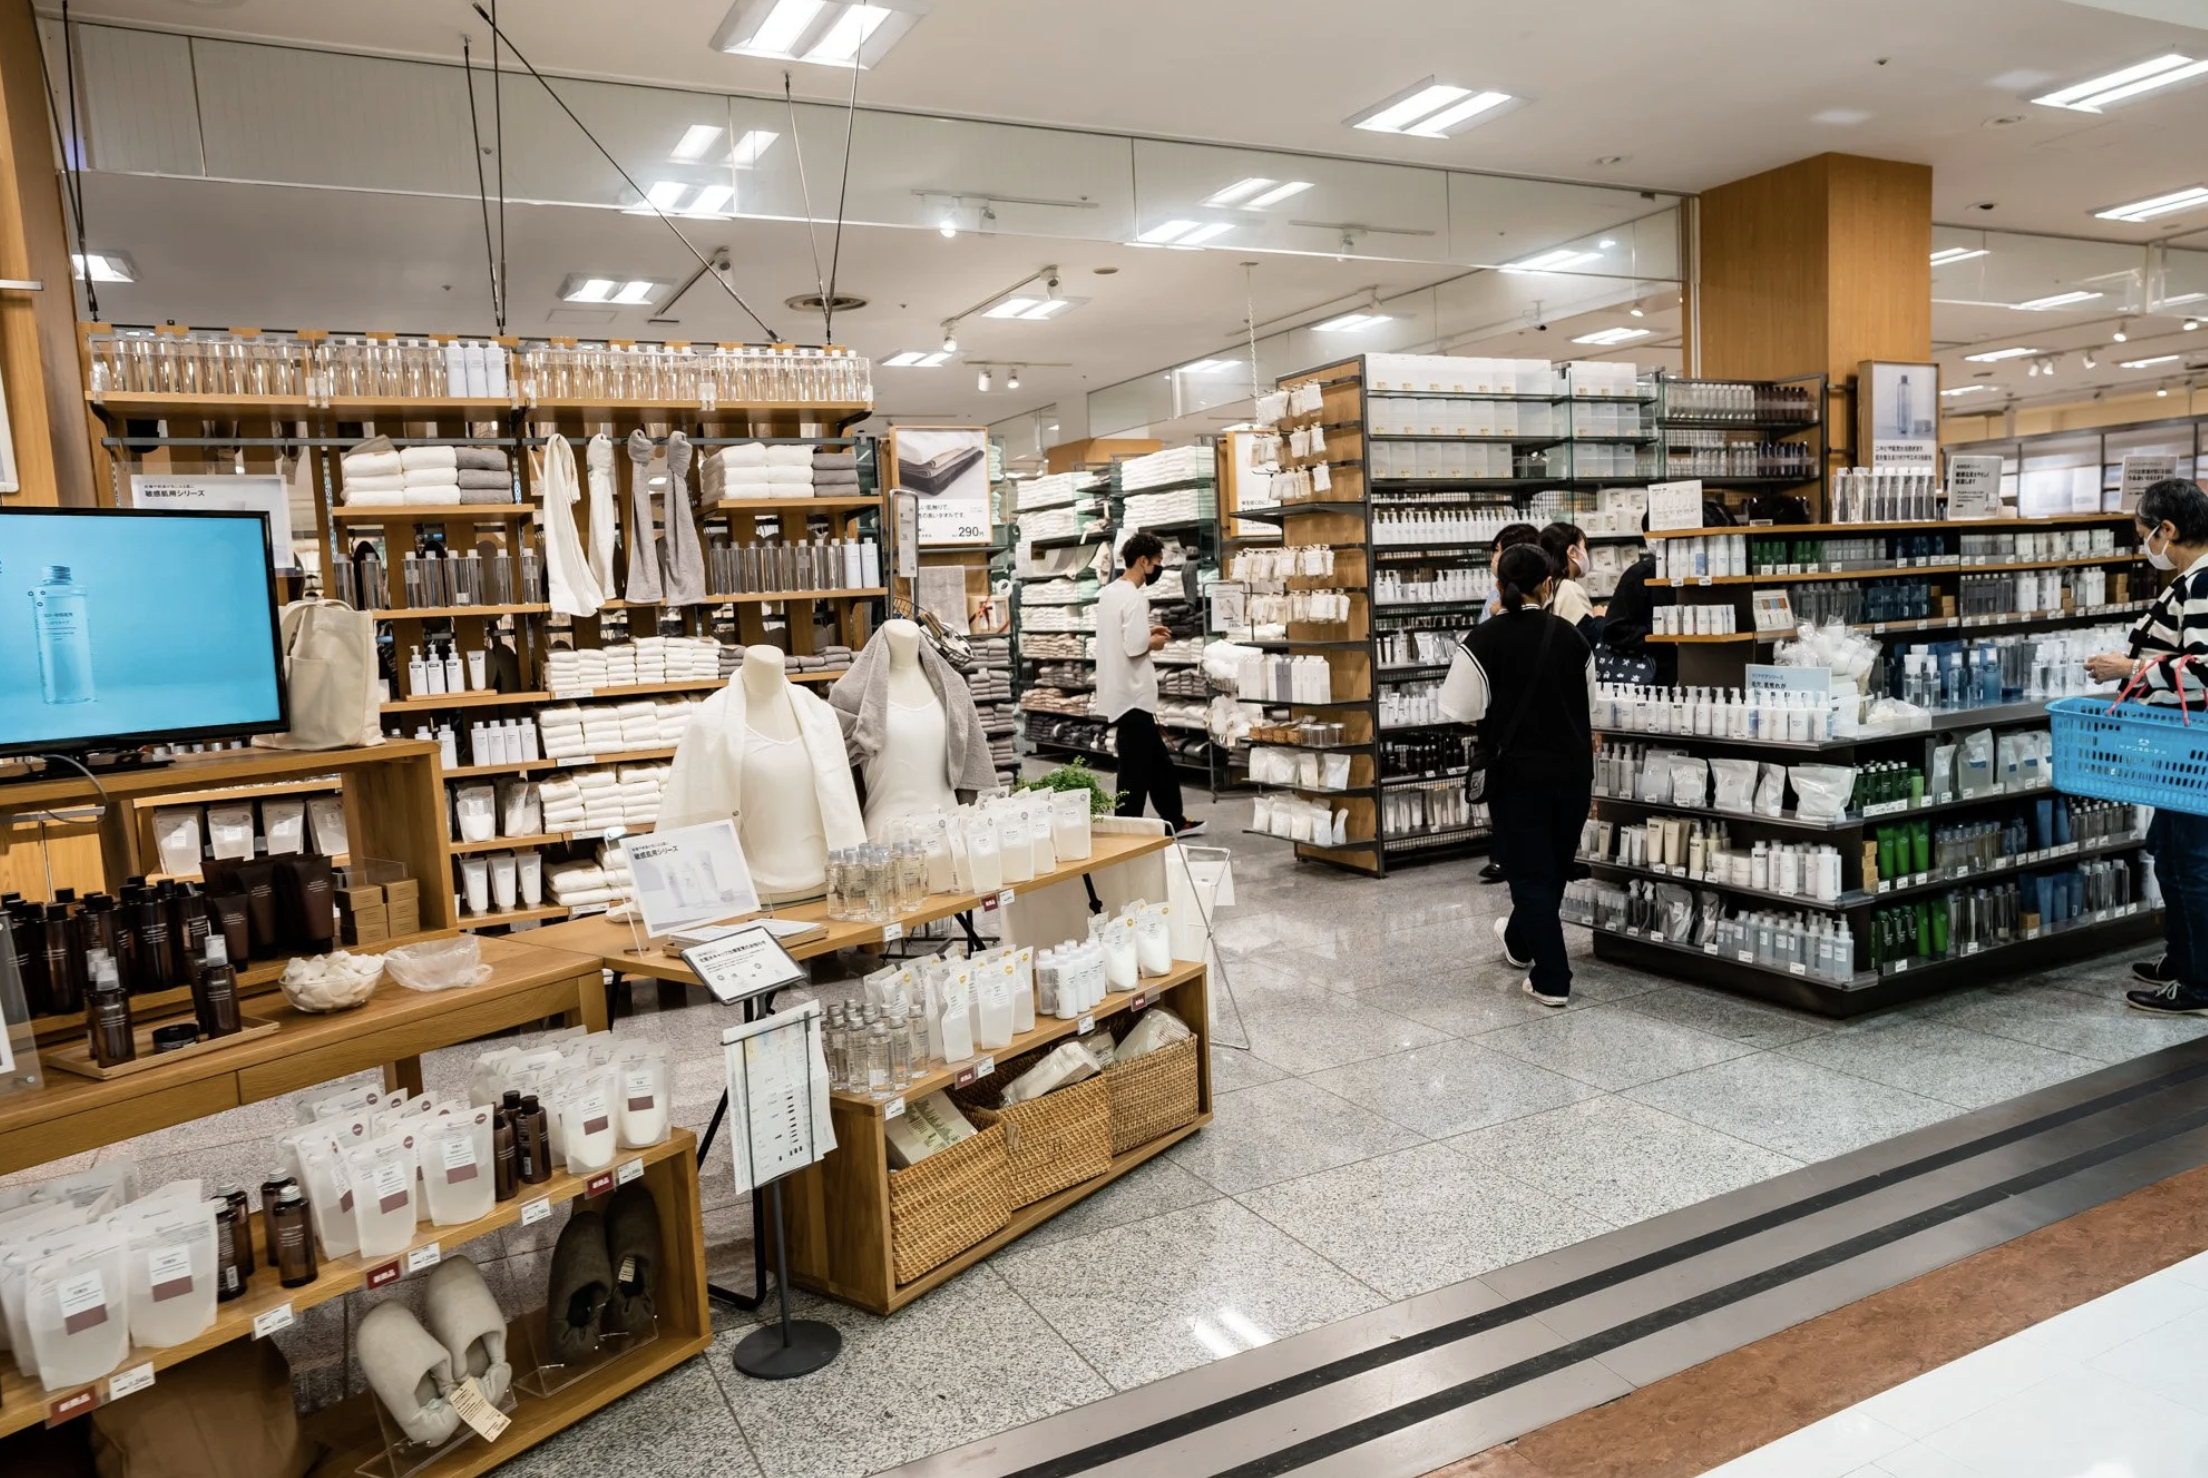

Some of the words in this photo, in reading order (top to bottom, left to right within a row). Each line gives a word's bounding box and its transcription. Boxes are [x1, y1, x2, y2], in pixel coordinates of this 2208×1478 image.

[145, 489, 206, 497] 敏感肌用シリーズ
[633, 845, 679, 861] 敏感肌用シリーズ
